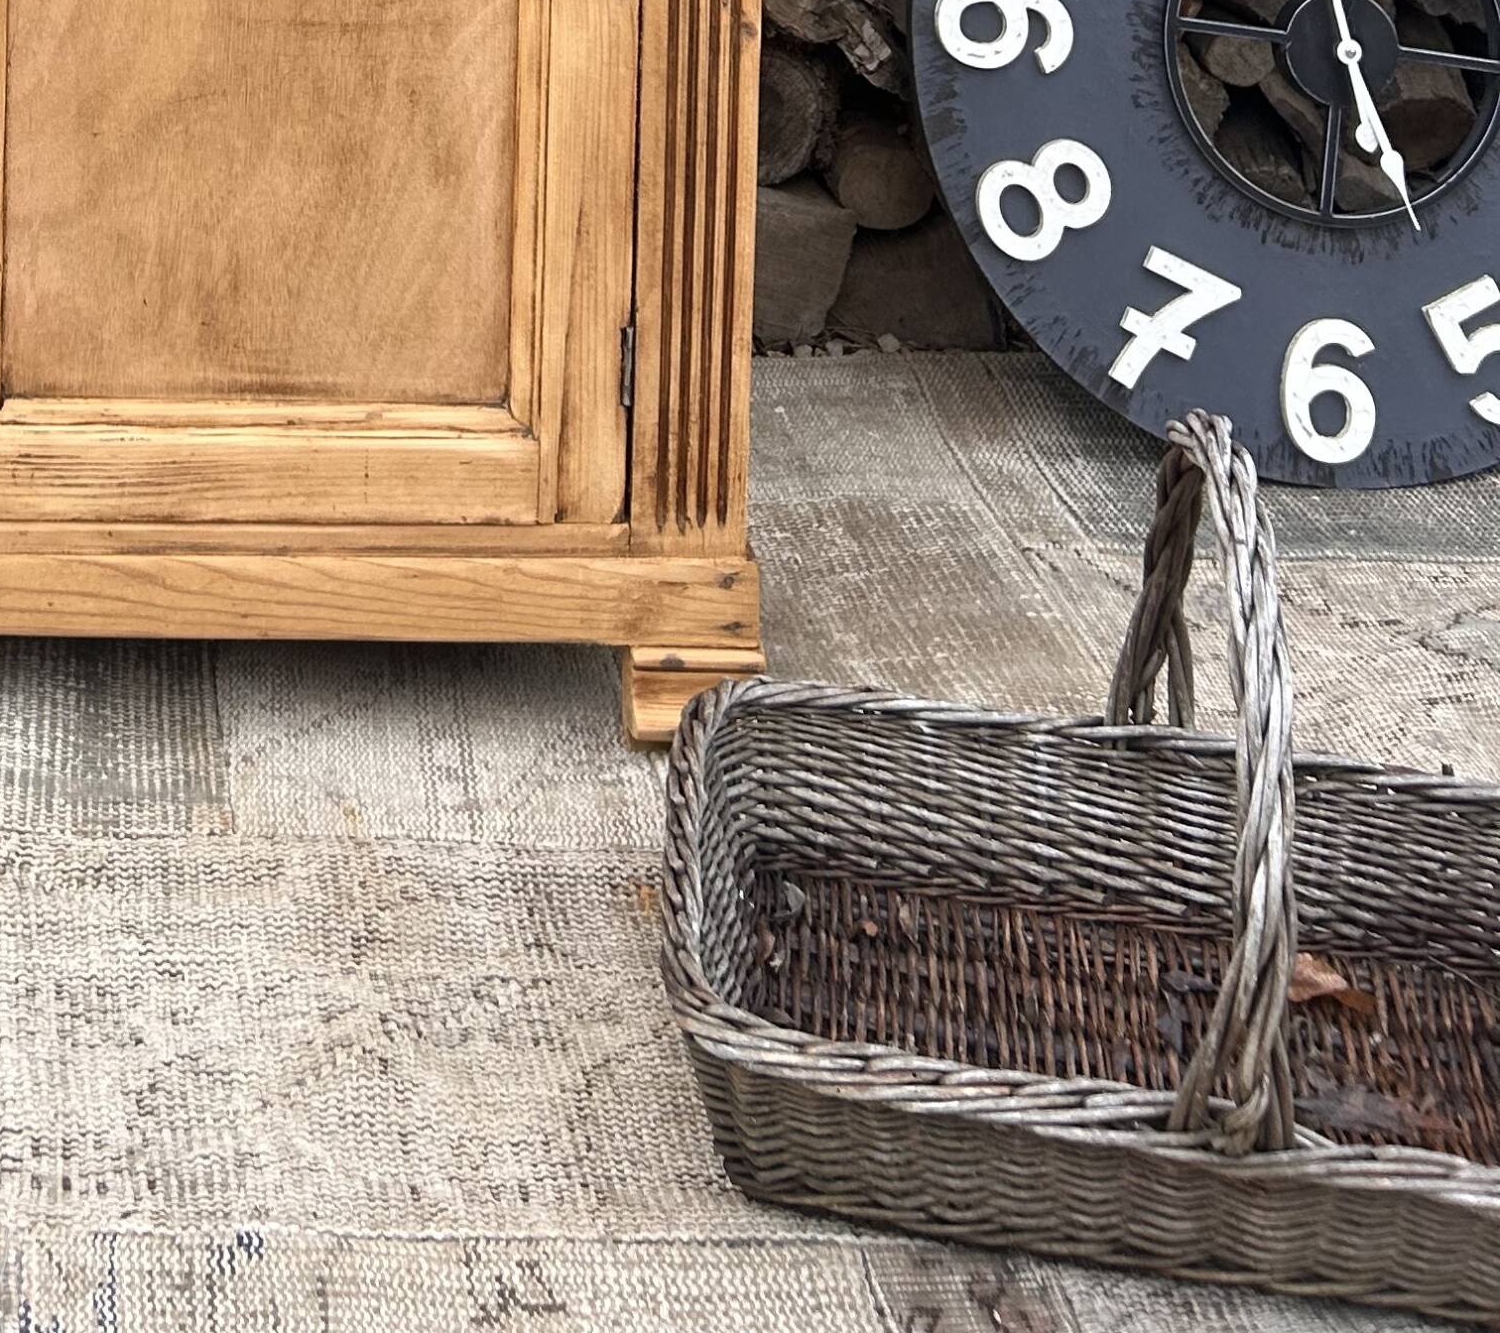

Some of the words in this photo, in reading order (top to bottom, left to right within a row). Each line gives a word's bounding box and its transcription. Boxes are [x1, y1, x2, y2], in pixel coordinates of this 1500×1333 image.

[975, 138, 1112, 262] 8
[1107, 244, 1242, 390] 7
[1279, 317, 1376, 464] 6
